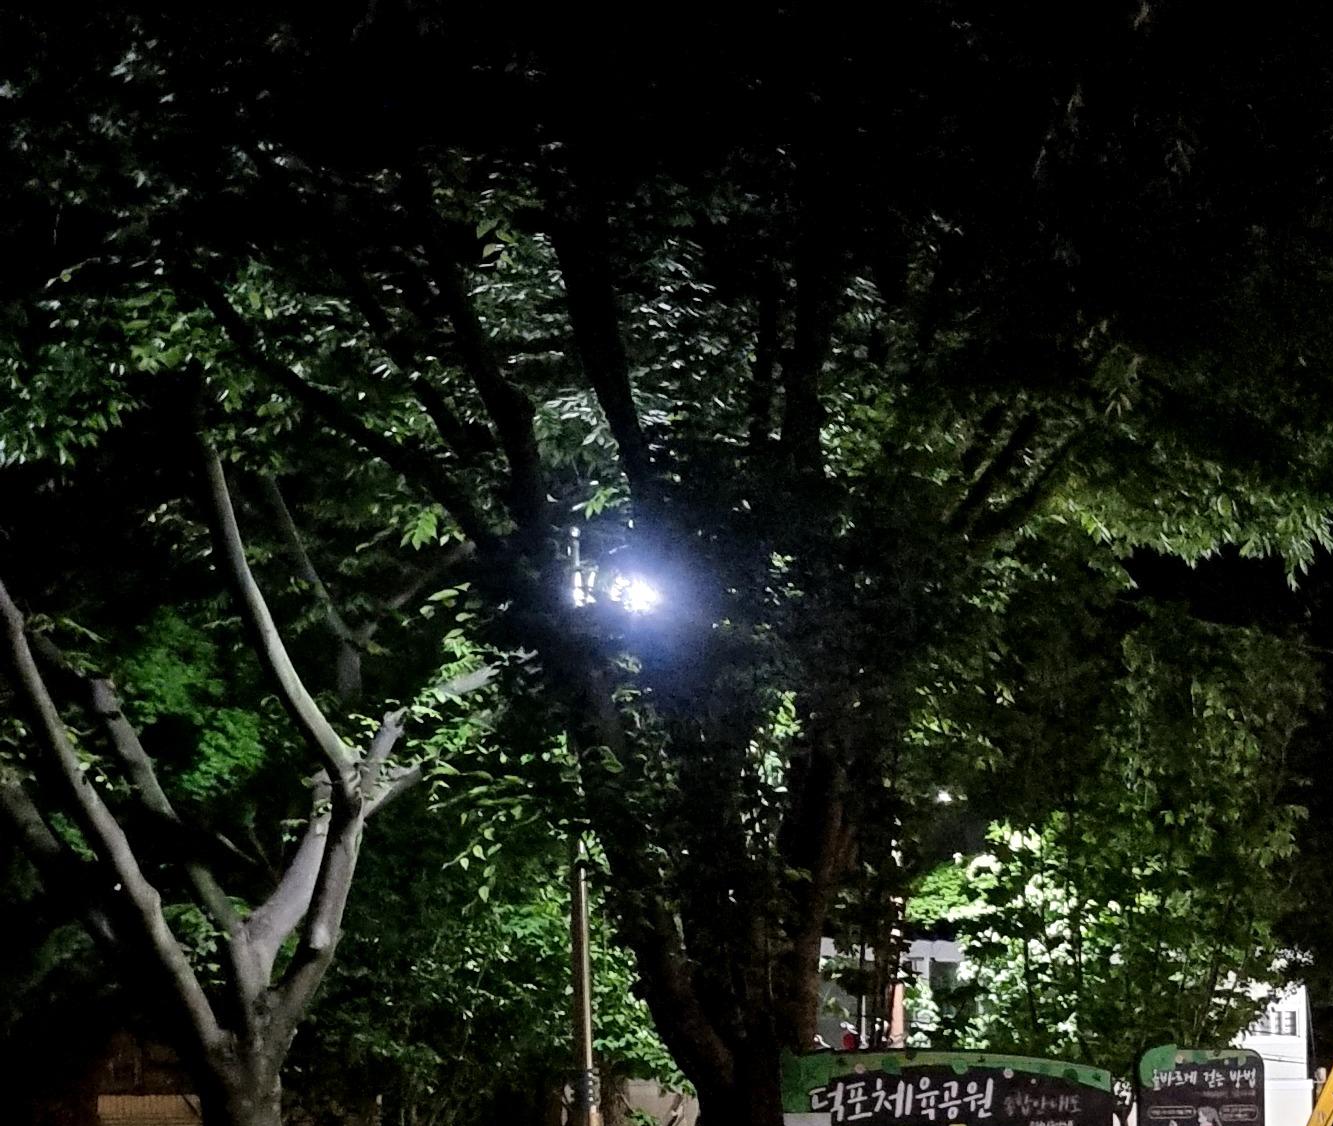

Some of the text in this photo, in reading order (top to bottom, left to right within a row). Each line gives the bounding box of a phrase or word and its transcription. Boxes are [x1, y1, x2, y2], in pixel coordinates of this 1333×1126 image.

[1152, 1067, 1257, 1091] 올바르게 걷는 방법
[809, 1076, 994, 1122] 덕포체육공원
